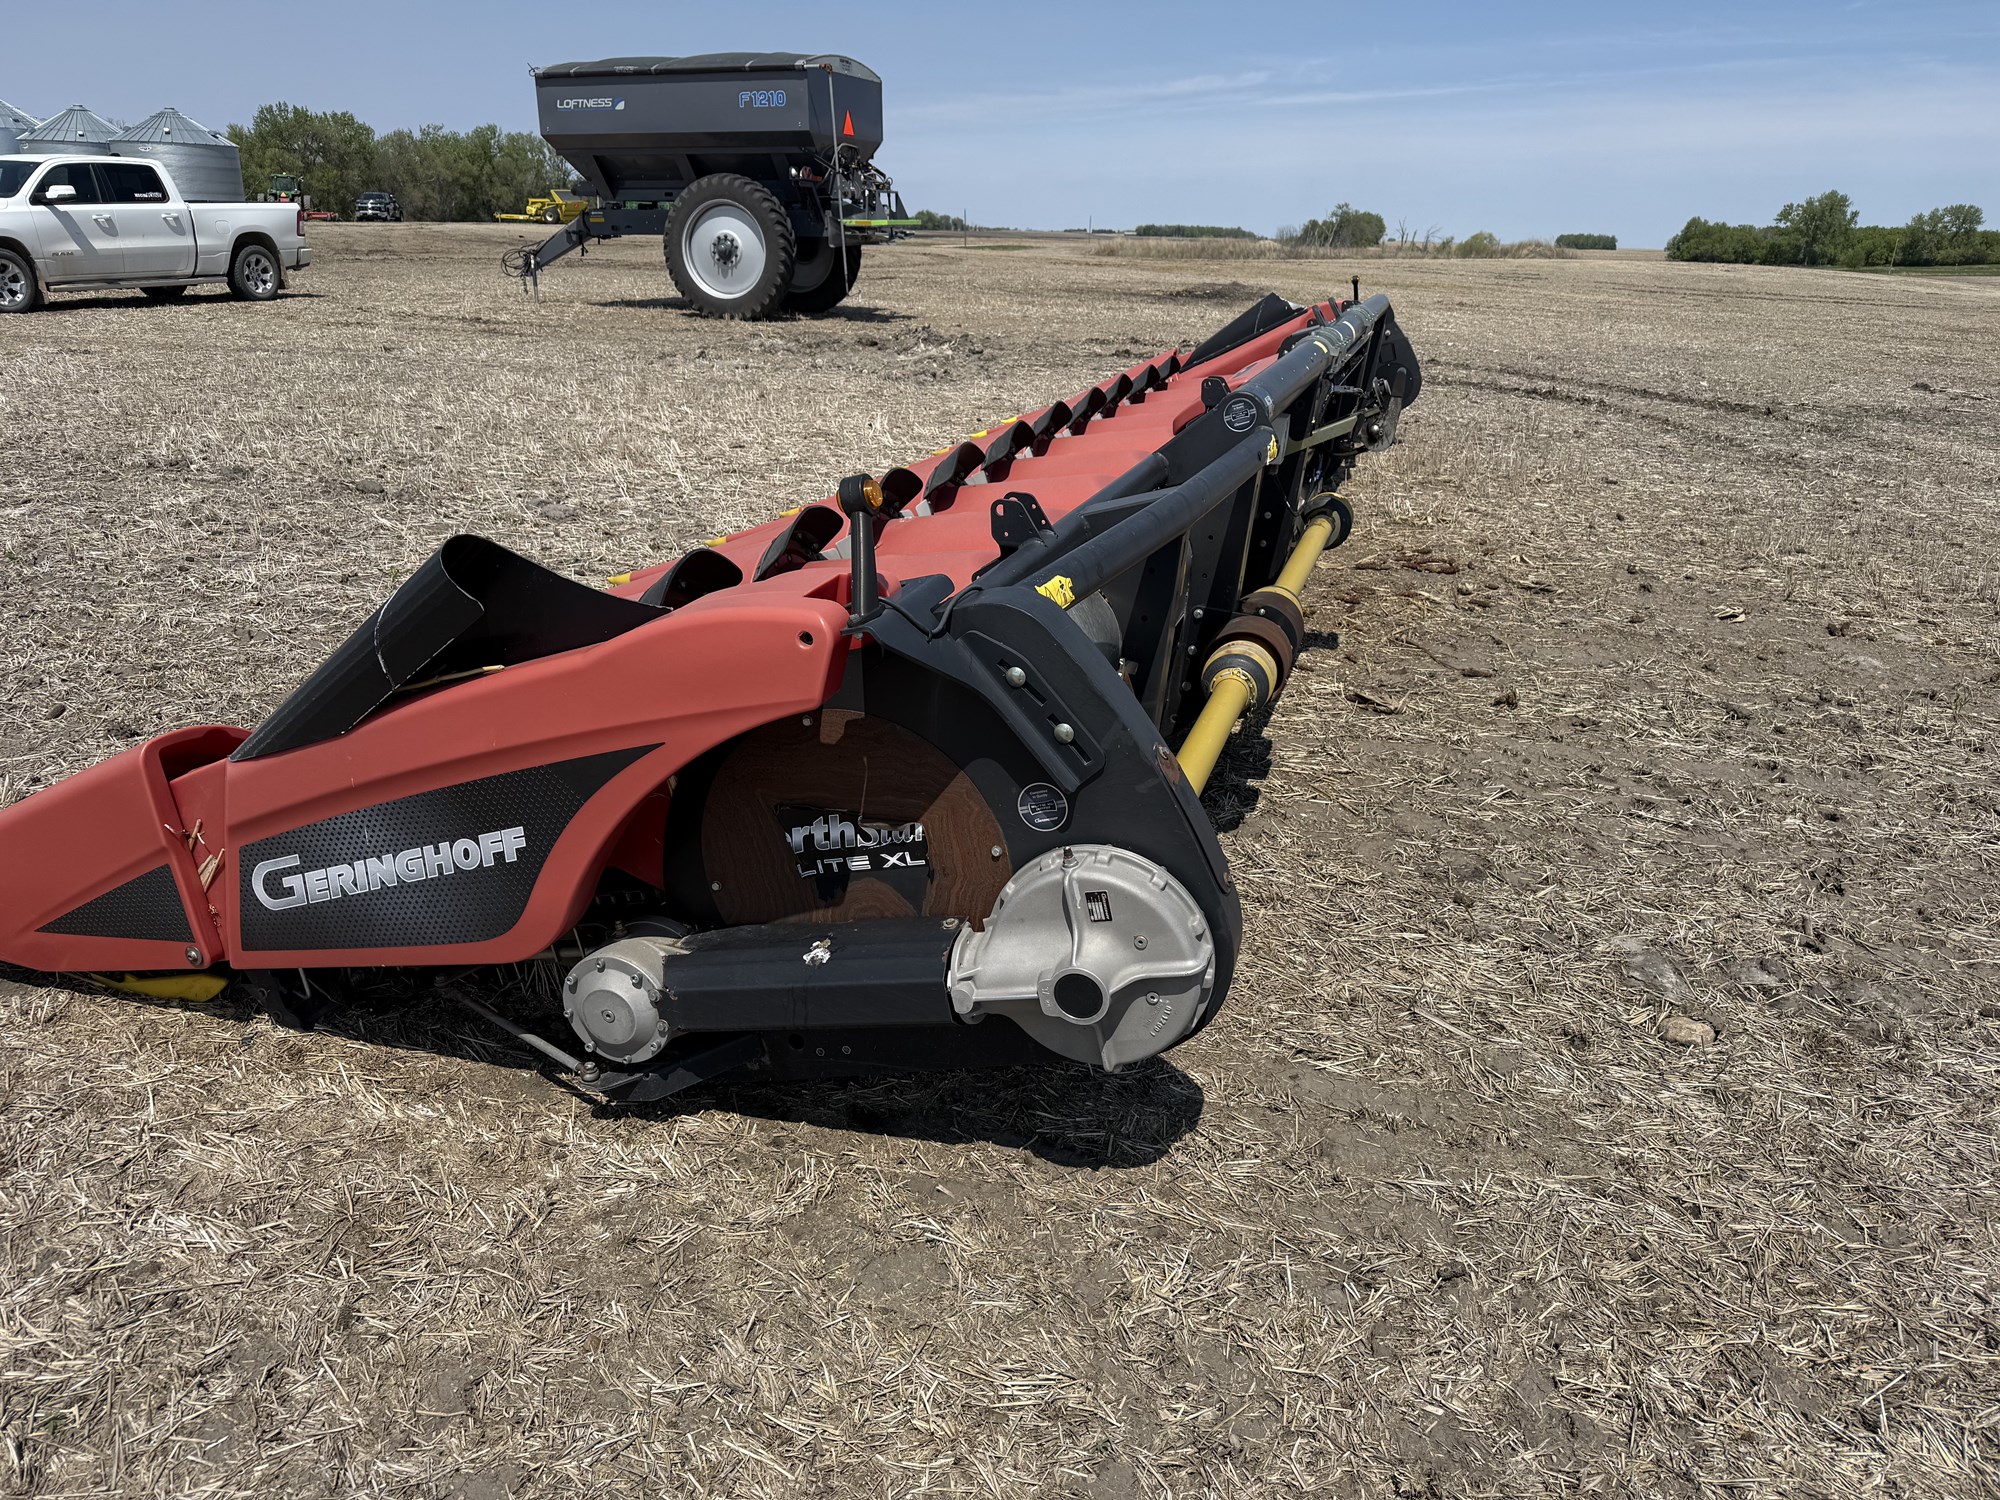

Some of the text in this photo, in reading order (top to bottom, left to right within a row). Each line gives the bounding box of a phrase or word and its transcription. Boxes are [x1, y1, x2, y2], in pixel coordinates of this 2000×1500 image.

[556, 97, 613, 110] LOFTNESS
[738, 89, 786, 108] F1210
[879, 851, 926, 869] XL
